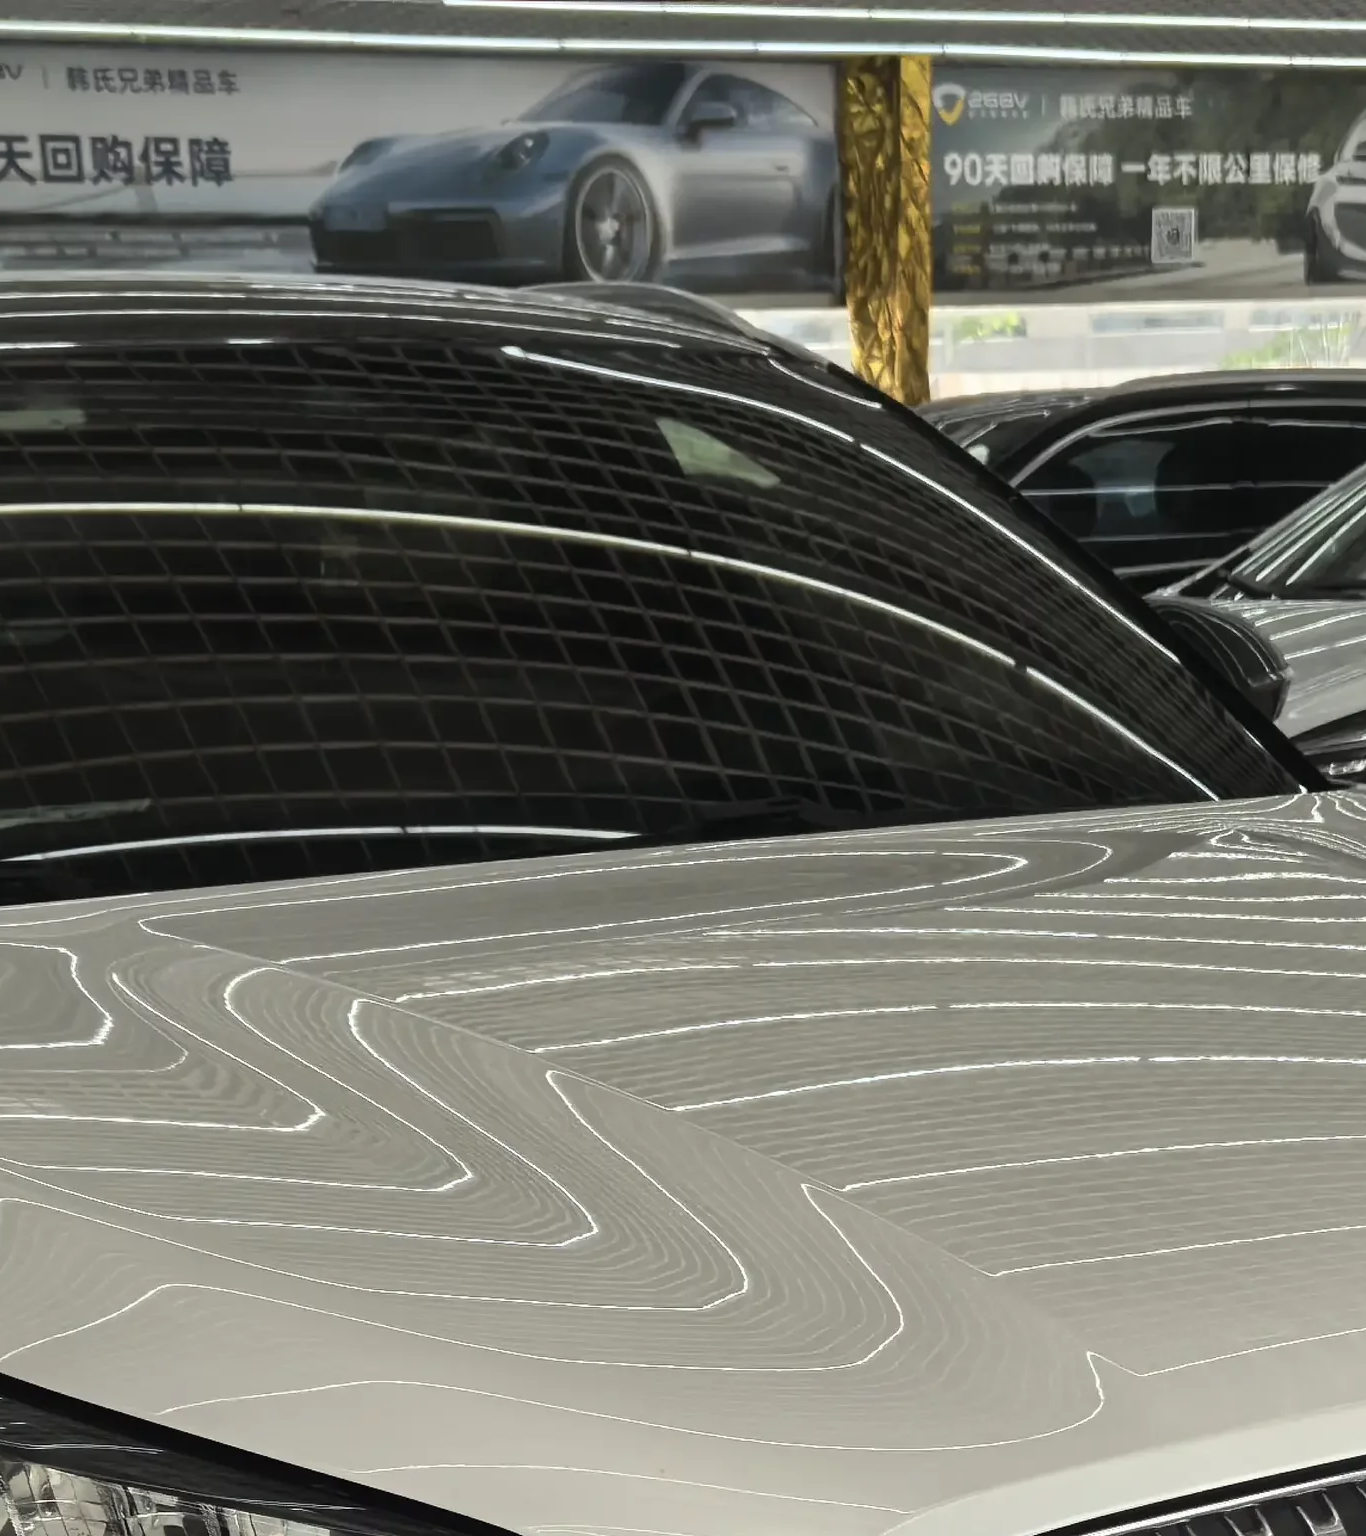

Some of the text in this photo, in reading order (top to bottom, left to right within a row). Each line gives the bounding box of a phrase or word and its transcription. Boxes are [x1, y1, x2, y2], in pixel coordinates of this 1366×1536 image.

[943, 151, 1115, 187] 90天回购保障
